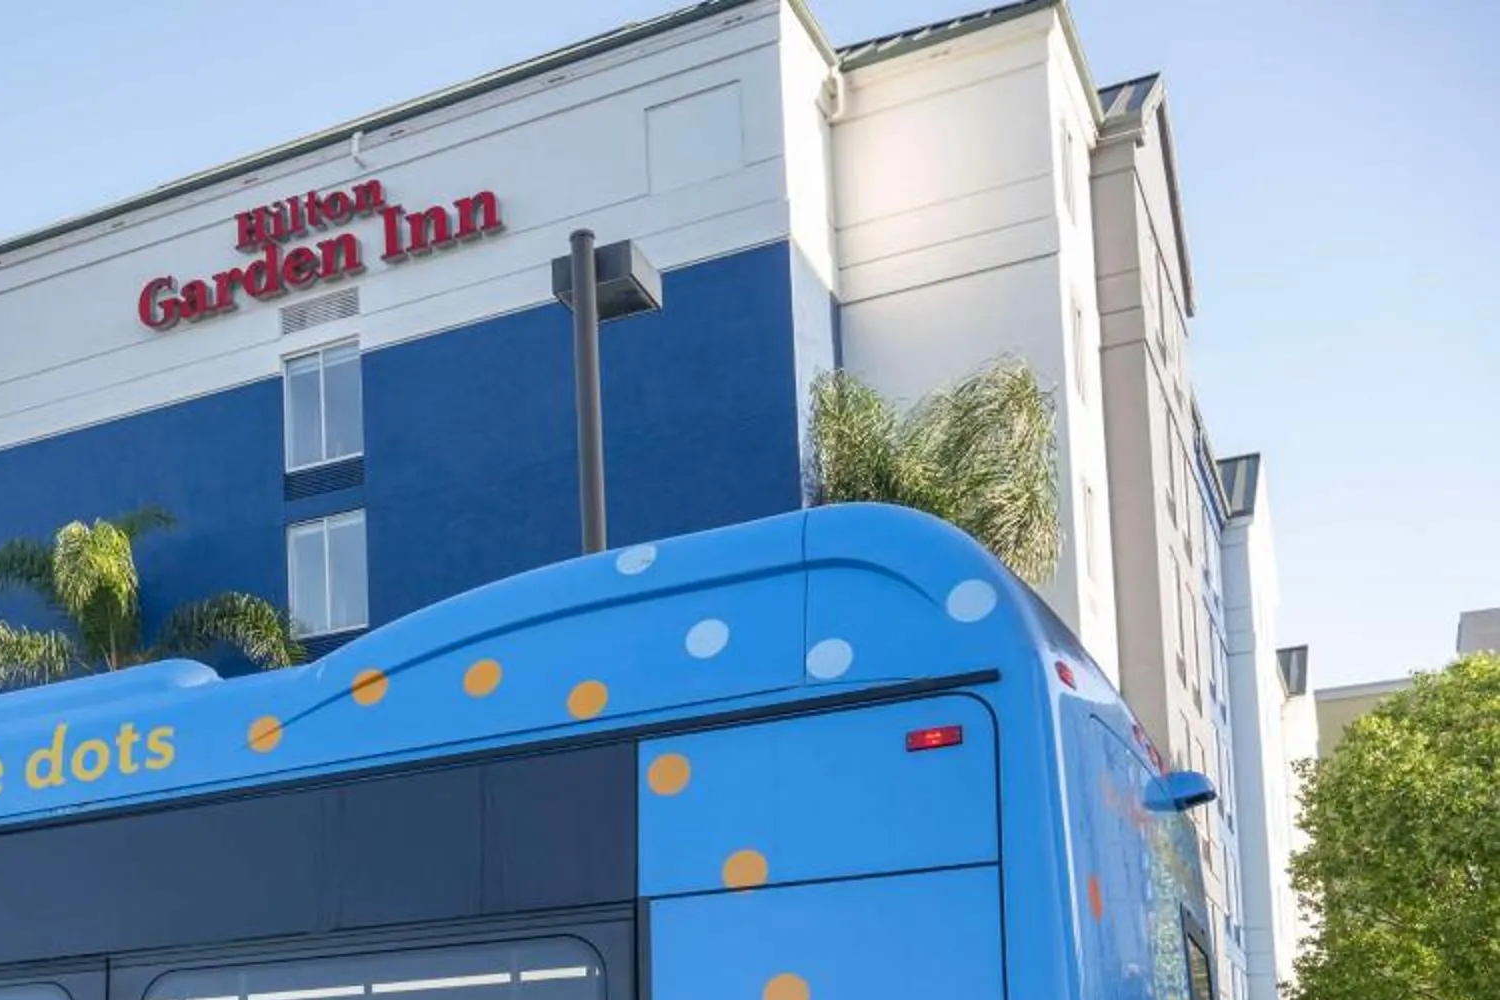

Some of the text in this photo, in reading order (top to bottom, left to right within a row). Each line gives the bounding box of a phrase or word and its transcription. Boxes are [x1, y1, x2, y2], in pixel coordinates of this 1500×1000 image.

[234, 177, 389, 252] Hilton
[137, 188, 506, 331] Garden Inn
[24, 721, 177, 790] dots
